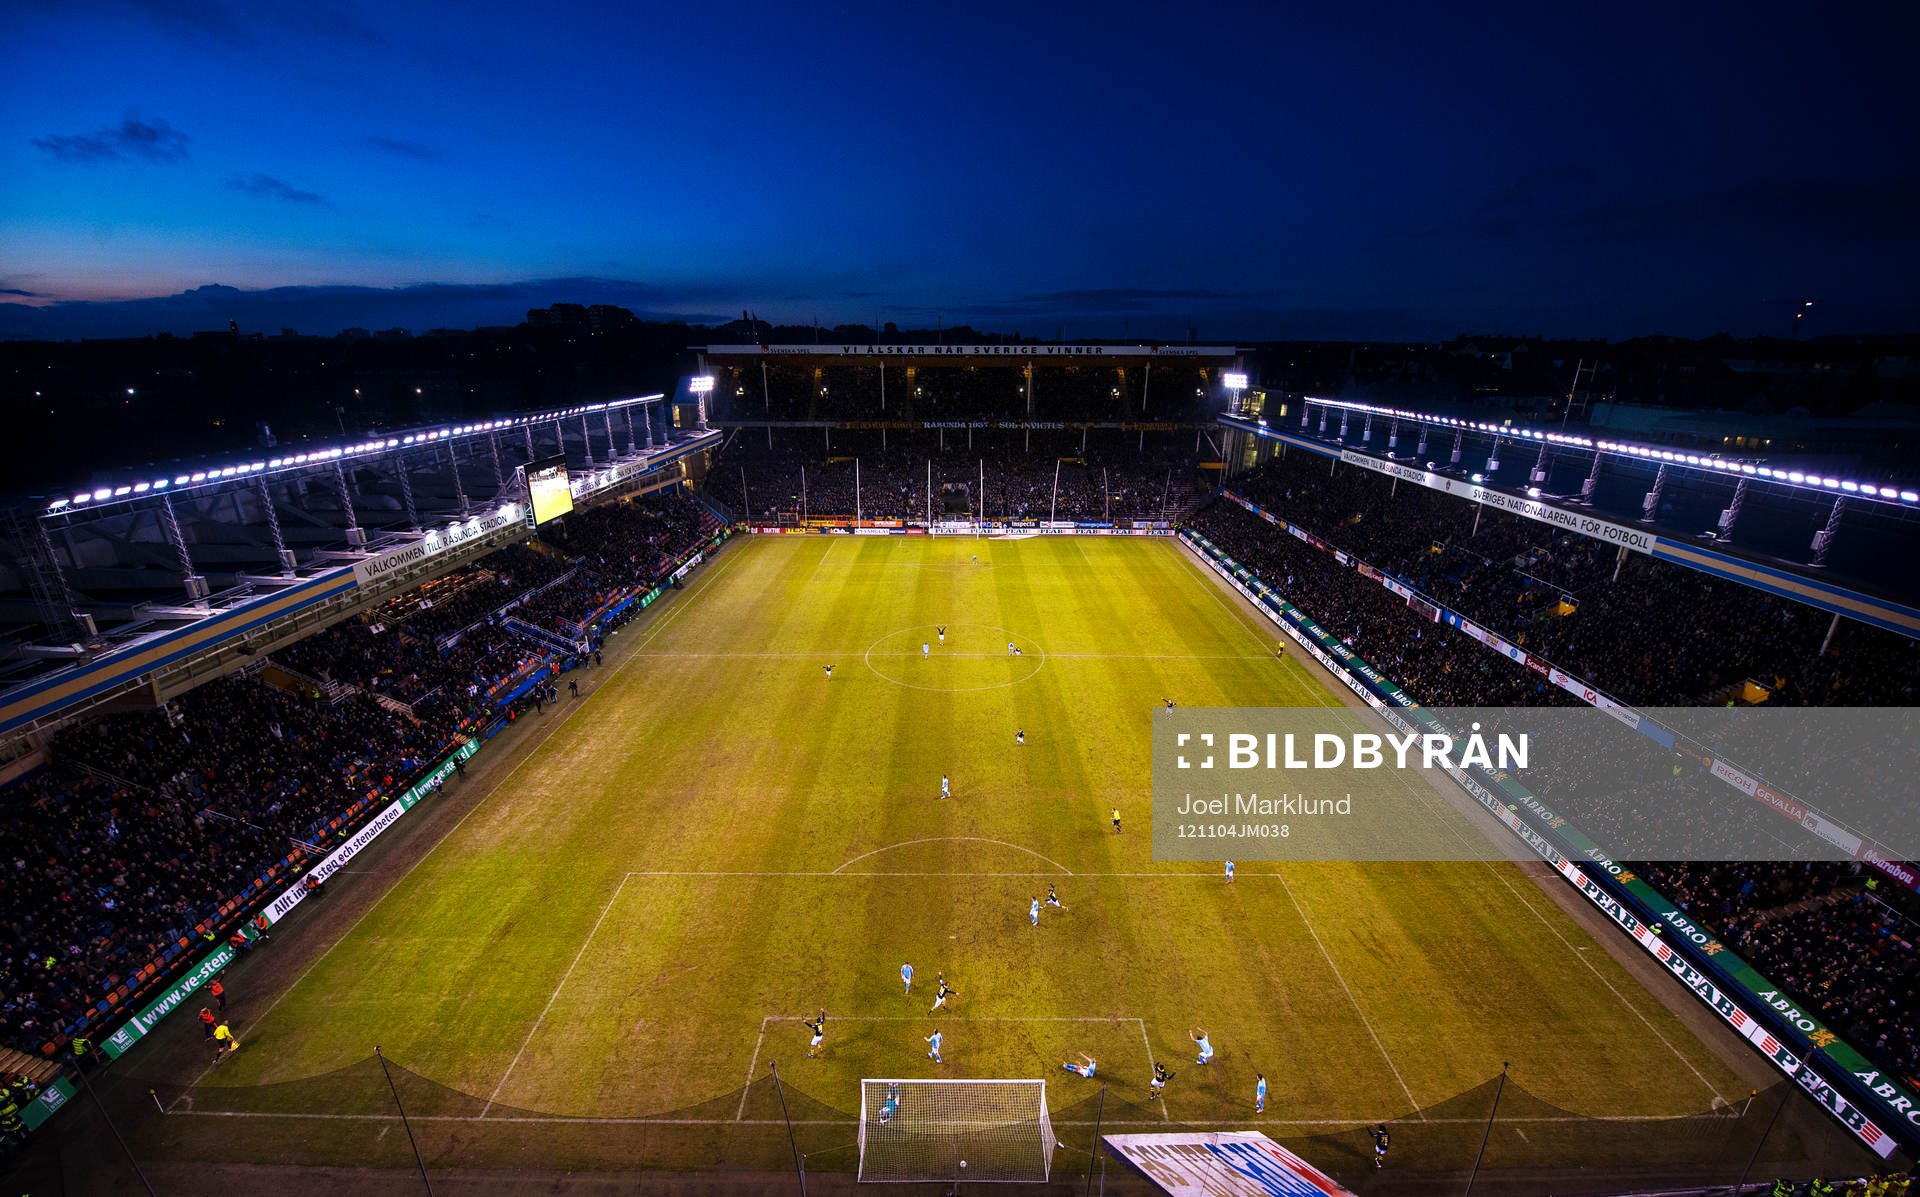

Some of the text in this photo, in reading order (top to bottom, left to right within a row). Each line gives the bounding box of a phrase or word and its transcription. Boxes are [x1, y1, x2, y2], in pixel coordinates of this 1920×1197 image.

[843, 346, 858, 354] VI
[974, 346, 1038, 355] SVERIGE
[1047, 346, 1103, 355] VINNER
[1473, 489, 1648, 549] SVERIGES NATIONALARENA FÖR FOTBOLL
[364, 546, 426, 577] VÄLKOMMEN
[427, 541, 442, 553] TILL
[480, 514, 507, 533] STADION
[1298, 635, 1315, 651] PEAB
[1321, 654, 1340, 675] PEAB
[1350, 679, 1371, 700] PEAB
[1583, 689, 1598, 705] ICA
[1381, 707, 1407, 732] PEAB
[1716, 765, 1752, 790] RICOH
[1462, 779, 1500, 811] PEAB
[1757, 788, 1802, 820] GEVALIA
[1520, 821, 1560, 865] PEAB
[273, 896, 291, 916] Allt
[317, 859, 339, 880] sten
[353, 808, 399, 850] stenarbeten
[1863, 849, 1914, 884] Marabou
[1583, 880, 1638, 932] PEAB
[1668, 953, 1737, 1018] PEAB
[1772, 1047, 1867, 1132] PEAB
